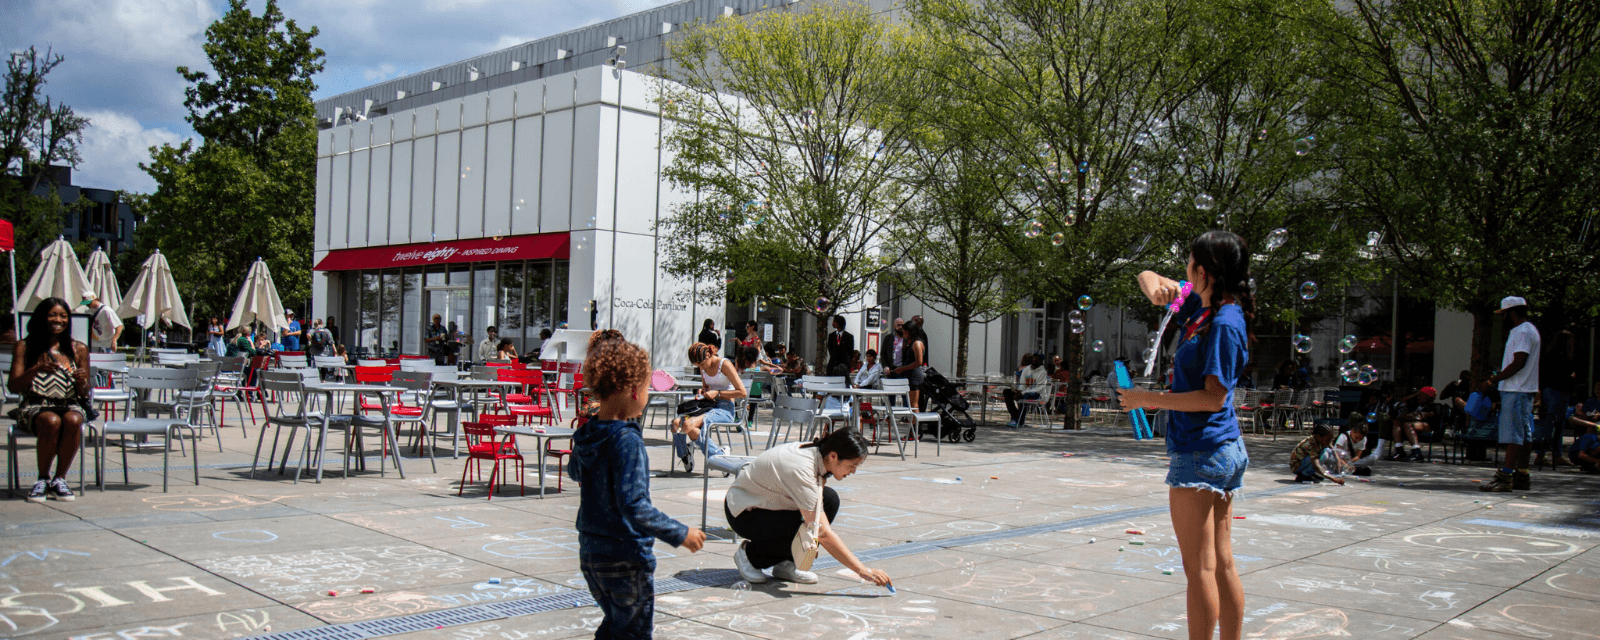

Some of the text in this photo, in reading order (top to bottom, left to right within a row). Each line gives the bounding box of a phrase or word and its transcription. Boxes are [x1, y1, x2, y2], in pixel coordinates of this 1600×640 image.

[392, 249, 424, 262] twelve
[423, 246, 459, 261] eighty
[461, 247, 492, 256] INSPIRED
[490, 246, 519, 255] DINING
[656, 300, 687, 311] Pavilion
